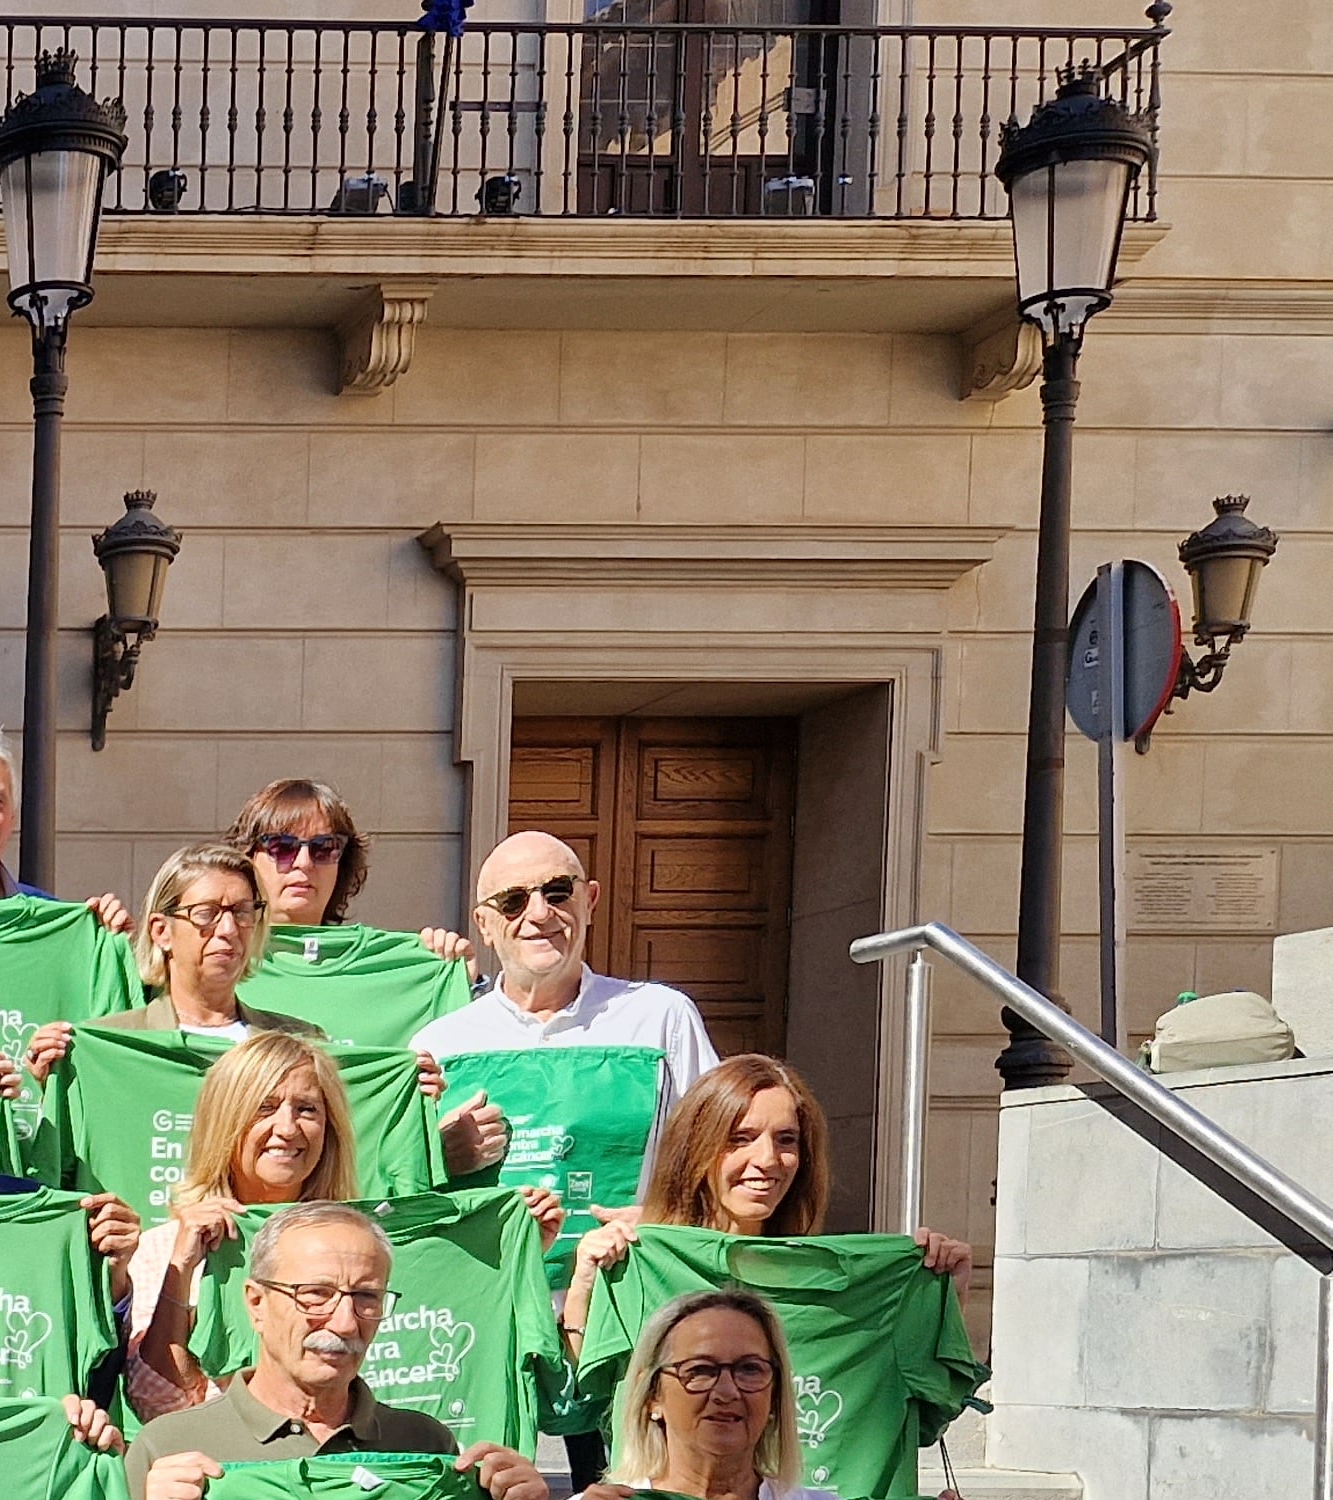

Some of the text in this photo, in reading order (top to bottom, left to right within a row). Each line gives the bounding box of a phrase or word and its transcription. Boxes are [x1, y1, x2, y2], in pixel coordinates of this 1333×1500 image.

[151, 1136, 182, 1159] En
[378, 1304, 454, 1333] archa
[366, 1339, 401, 1361] tra
